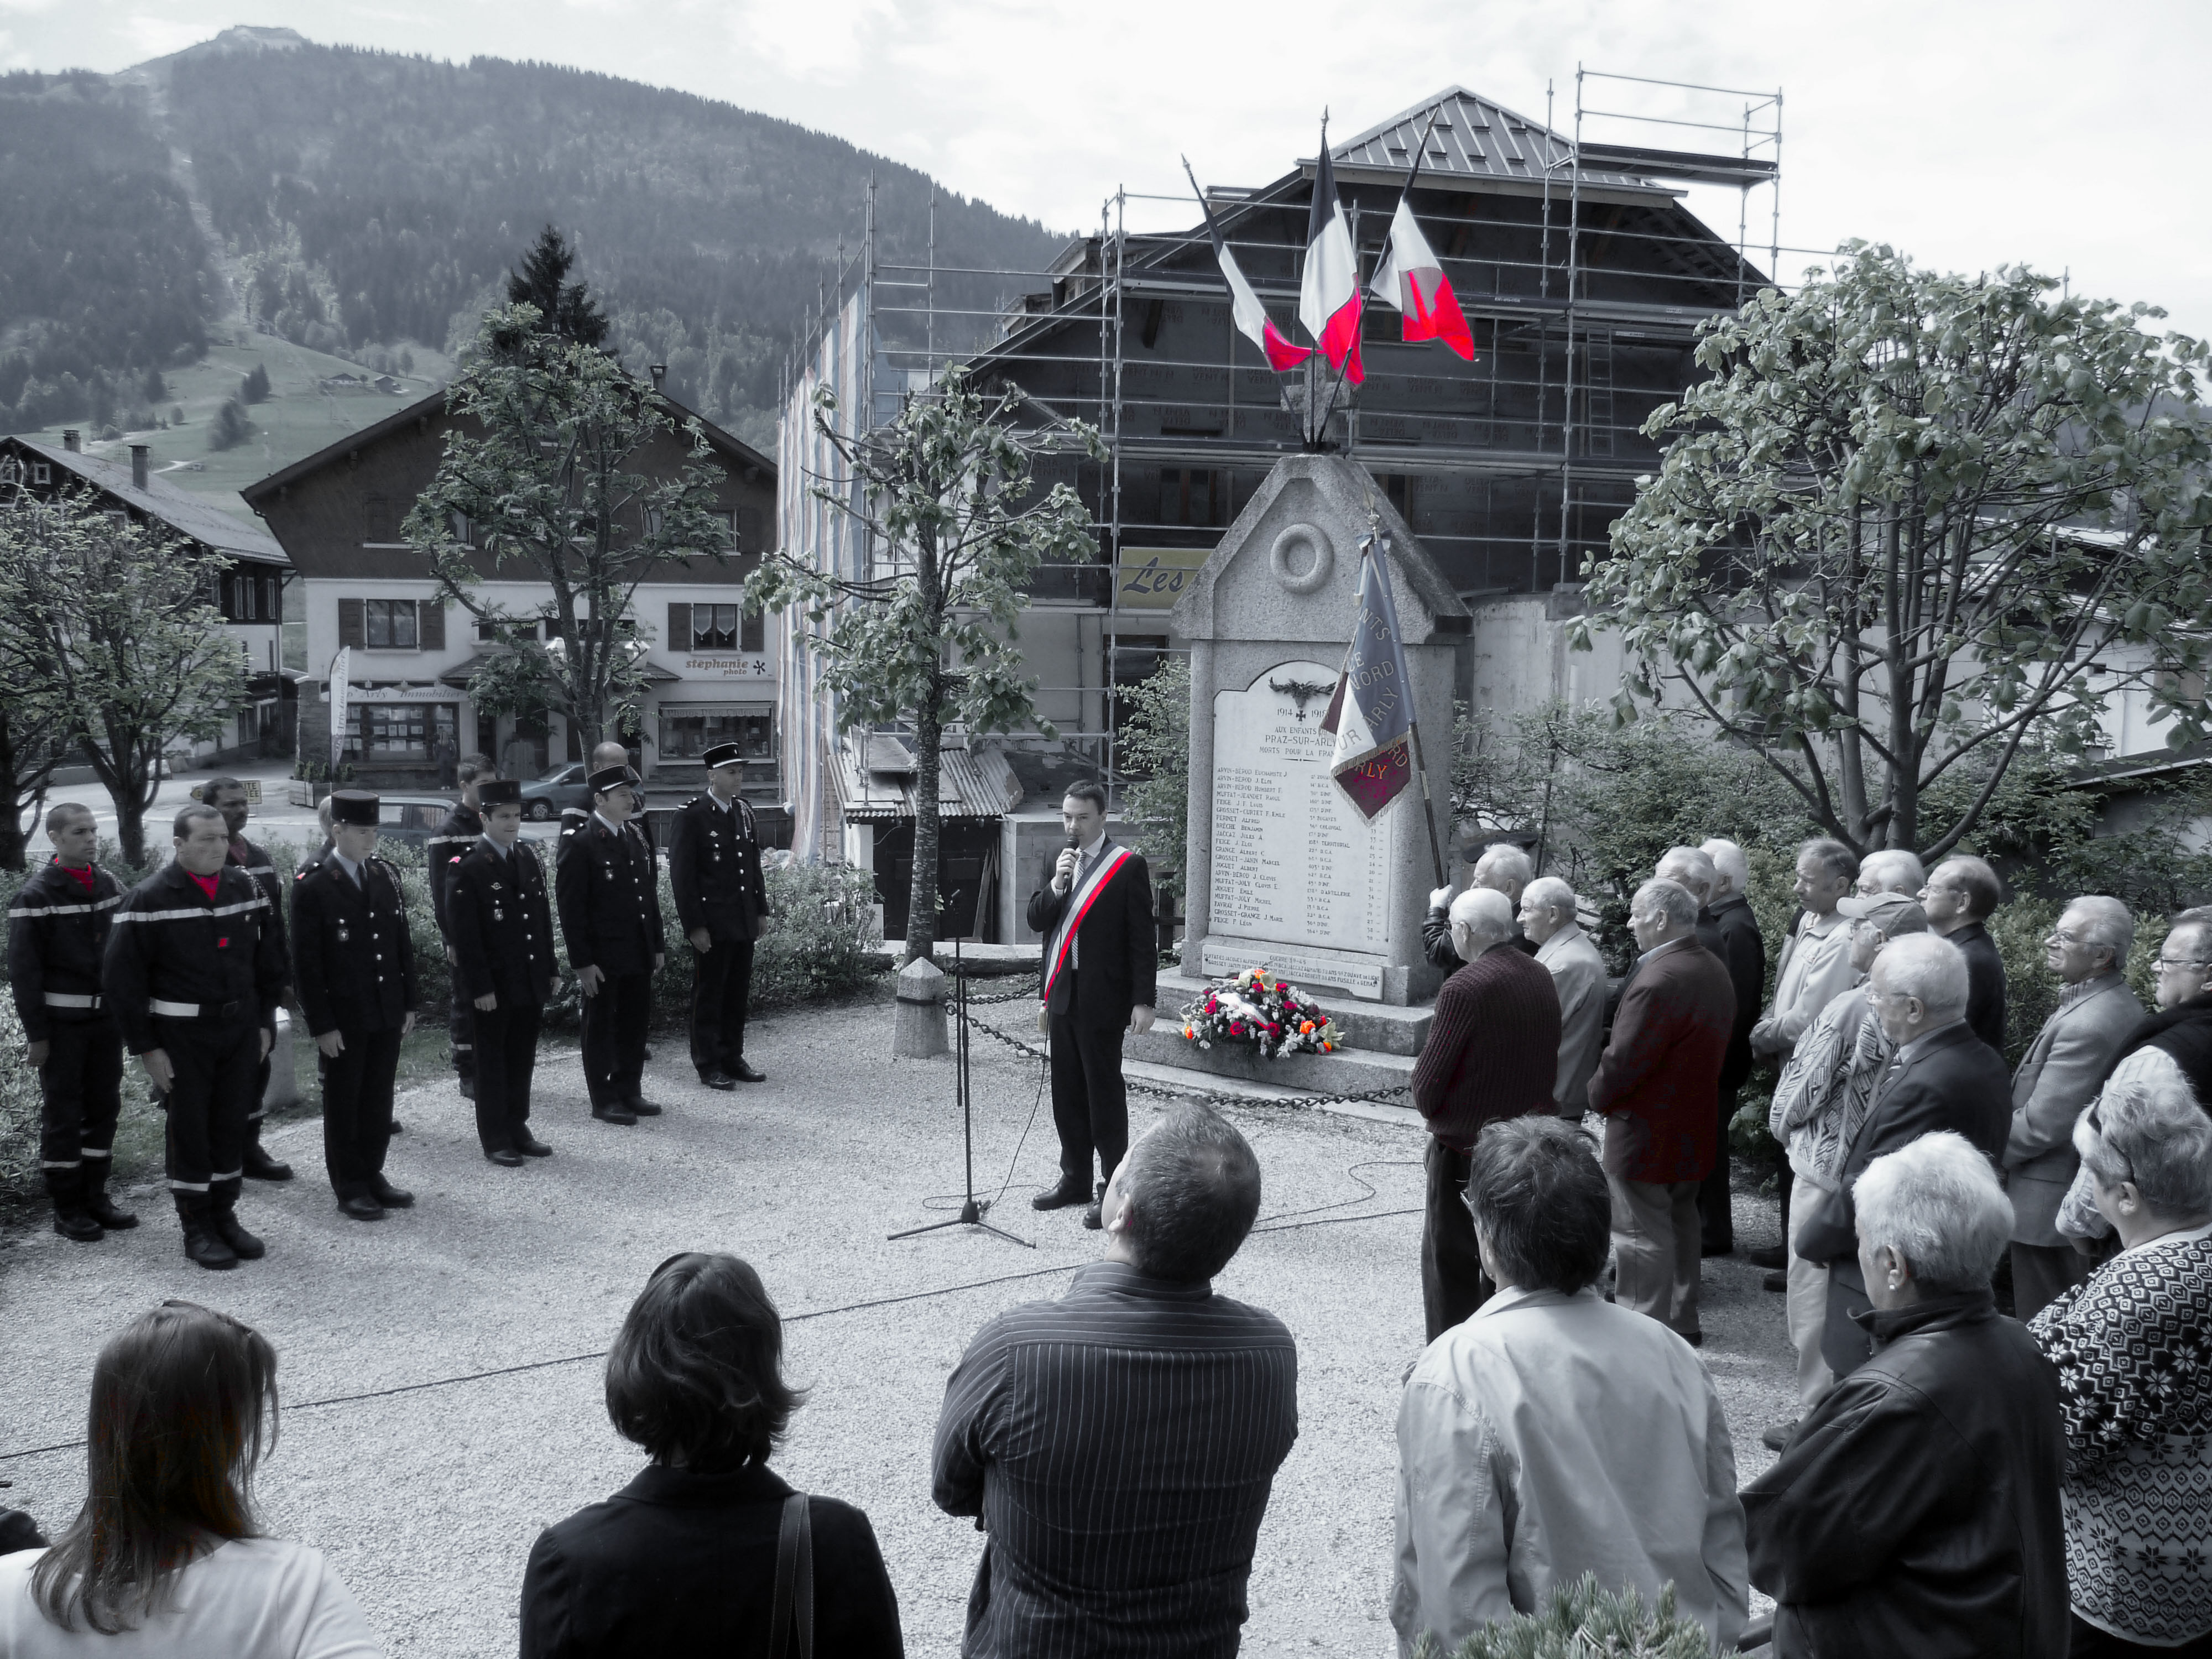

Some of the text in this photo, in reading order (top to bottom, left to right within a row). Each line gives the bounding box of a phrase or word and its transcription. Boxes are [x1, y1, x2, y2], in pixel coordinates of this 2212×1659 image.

[1123, 556, 1184, 594] Les
[1359, 608, 1391, 640] NTS
[1277, 708, 1293, 716] 1914
[1337, 687, 1399, 751] UR ARLY
[1266, 735, 1336, 747] PRAZ-SUR-ARLY
[1354, 761, 1388, 780] RLY
